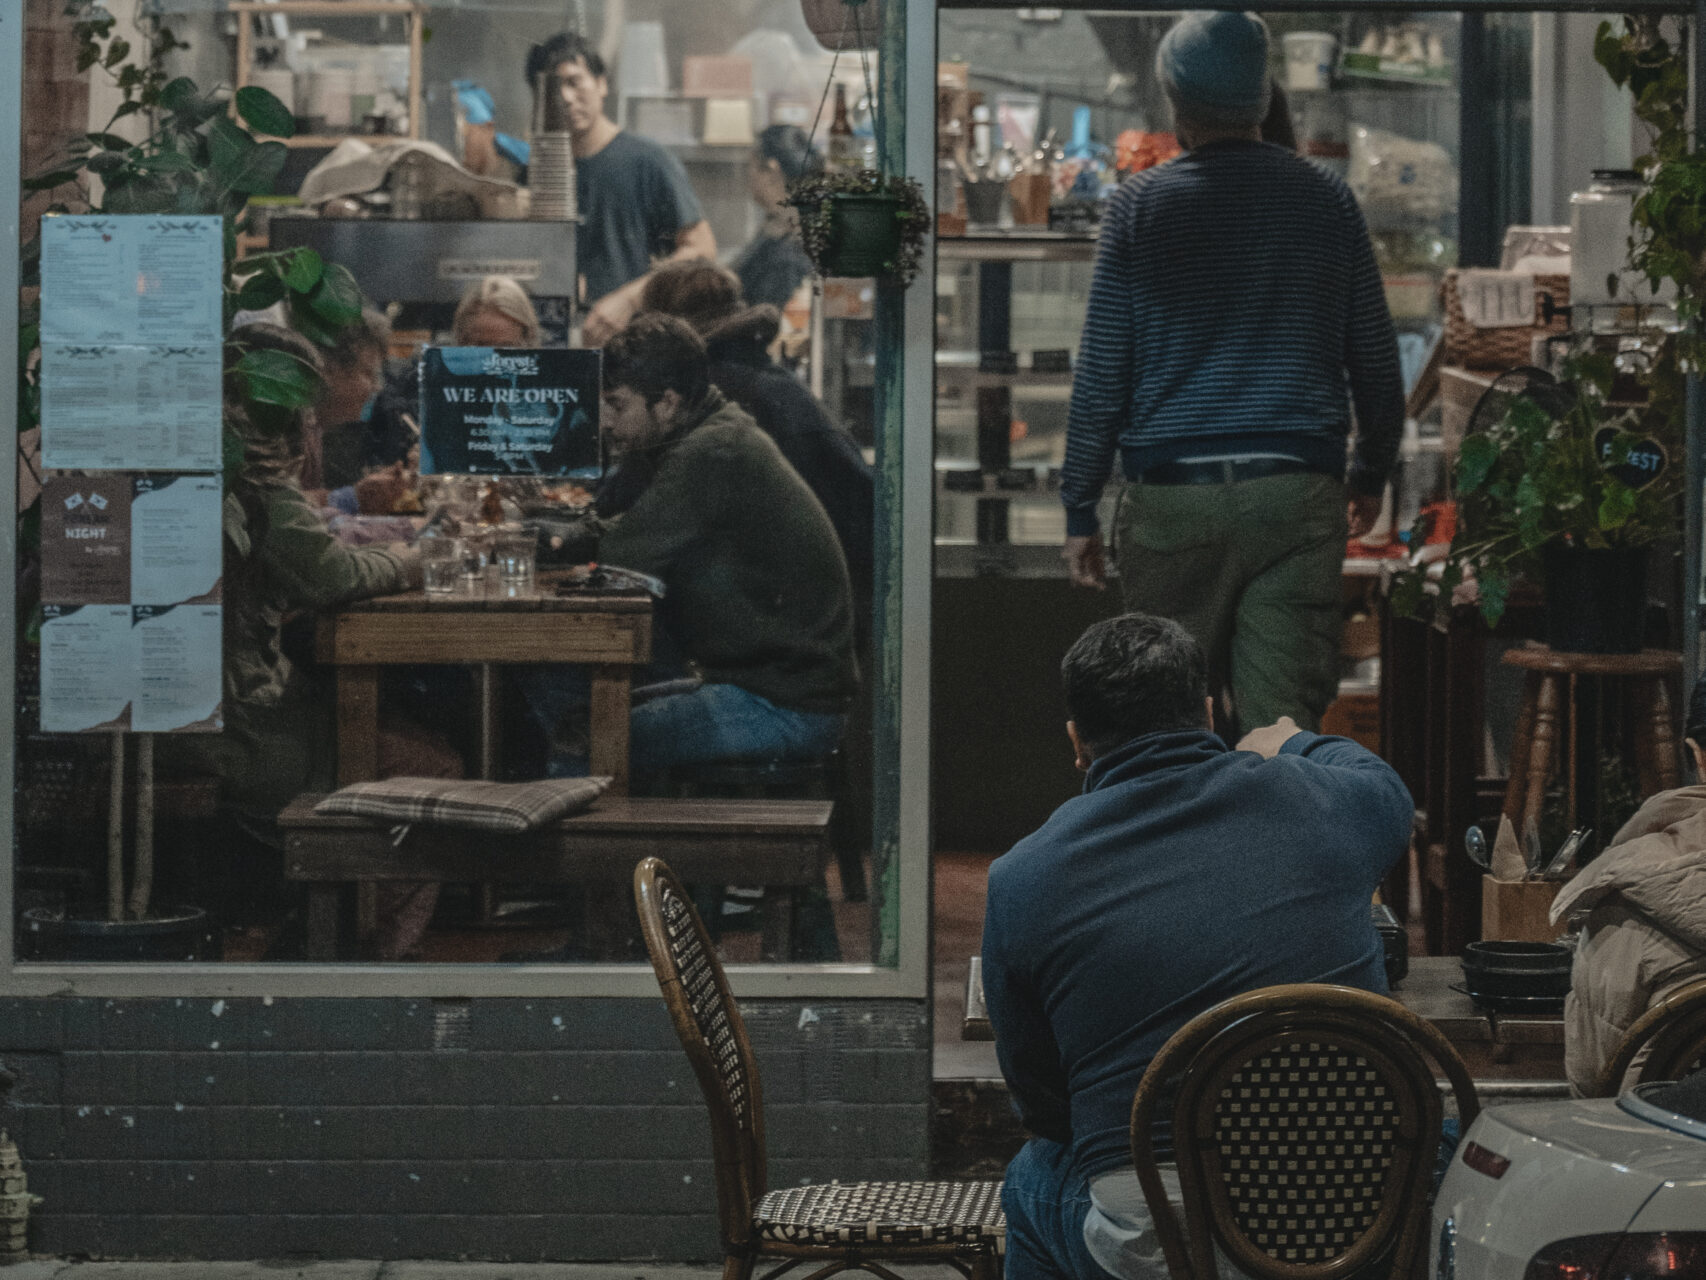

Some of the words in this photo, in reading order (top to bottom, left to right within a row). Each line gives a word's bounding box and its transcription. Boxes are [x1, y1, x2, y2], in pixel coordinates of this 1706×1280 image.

[443, 388, 476, 403] WE
[480, 388, 521, 403] ARE
[524, 388, 579, 403] OPEN
[463, 415, 503, 426] Monday
[511, 415, 555, 426] Saturday
[467, 441, 498, 452] Friday
[509, 441, 553, 452] Saturday
[65, 527, 107, 539] NIGHT
